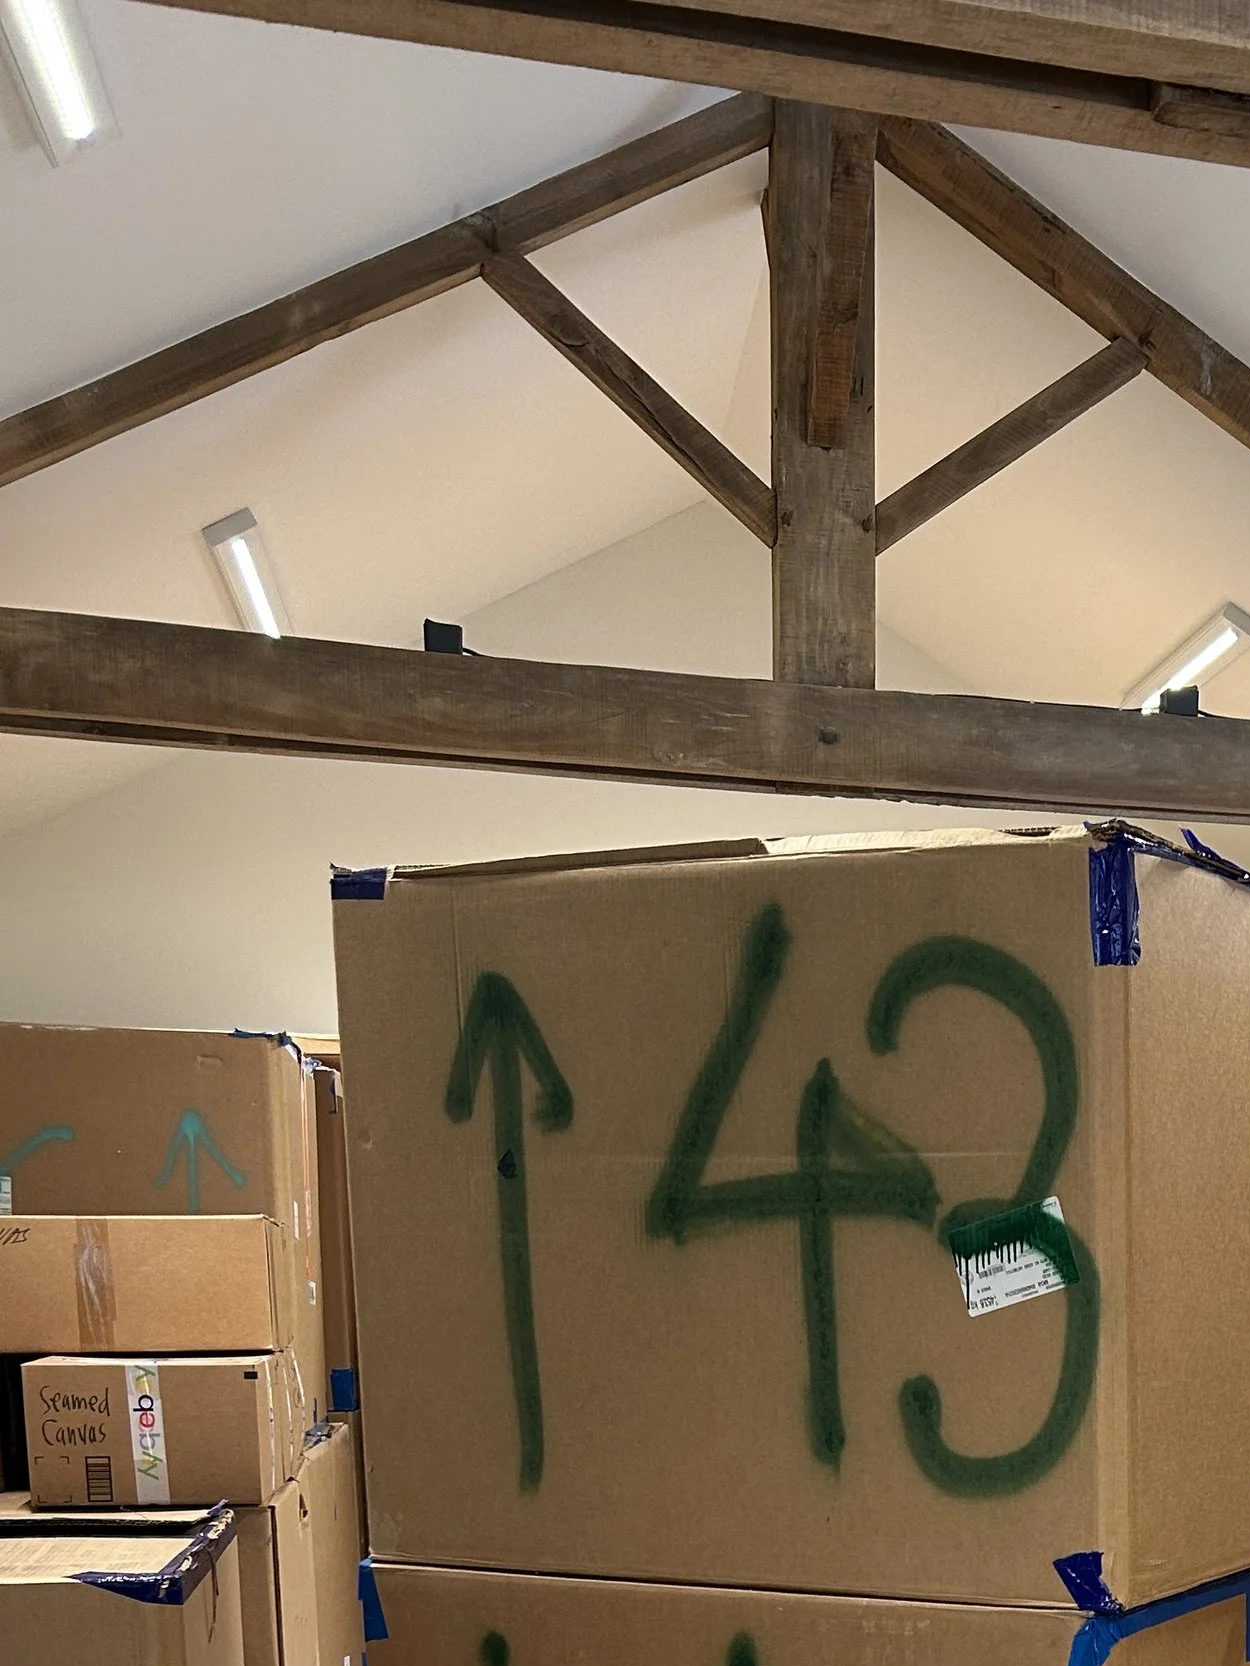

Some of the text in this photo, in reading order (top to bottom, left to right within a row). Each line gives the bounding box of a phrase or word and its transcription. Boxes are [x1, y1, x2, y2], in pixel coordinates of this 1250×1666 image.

[645, 899, 1100, 1501] 43
[40, 1385, 111, 1417] Seamed
[41, 1419, 107, 1447] Canvas
